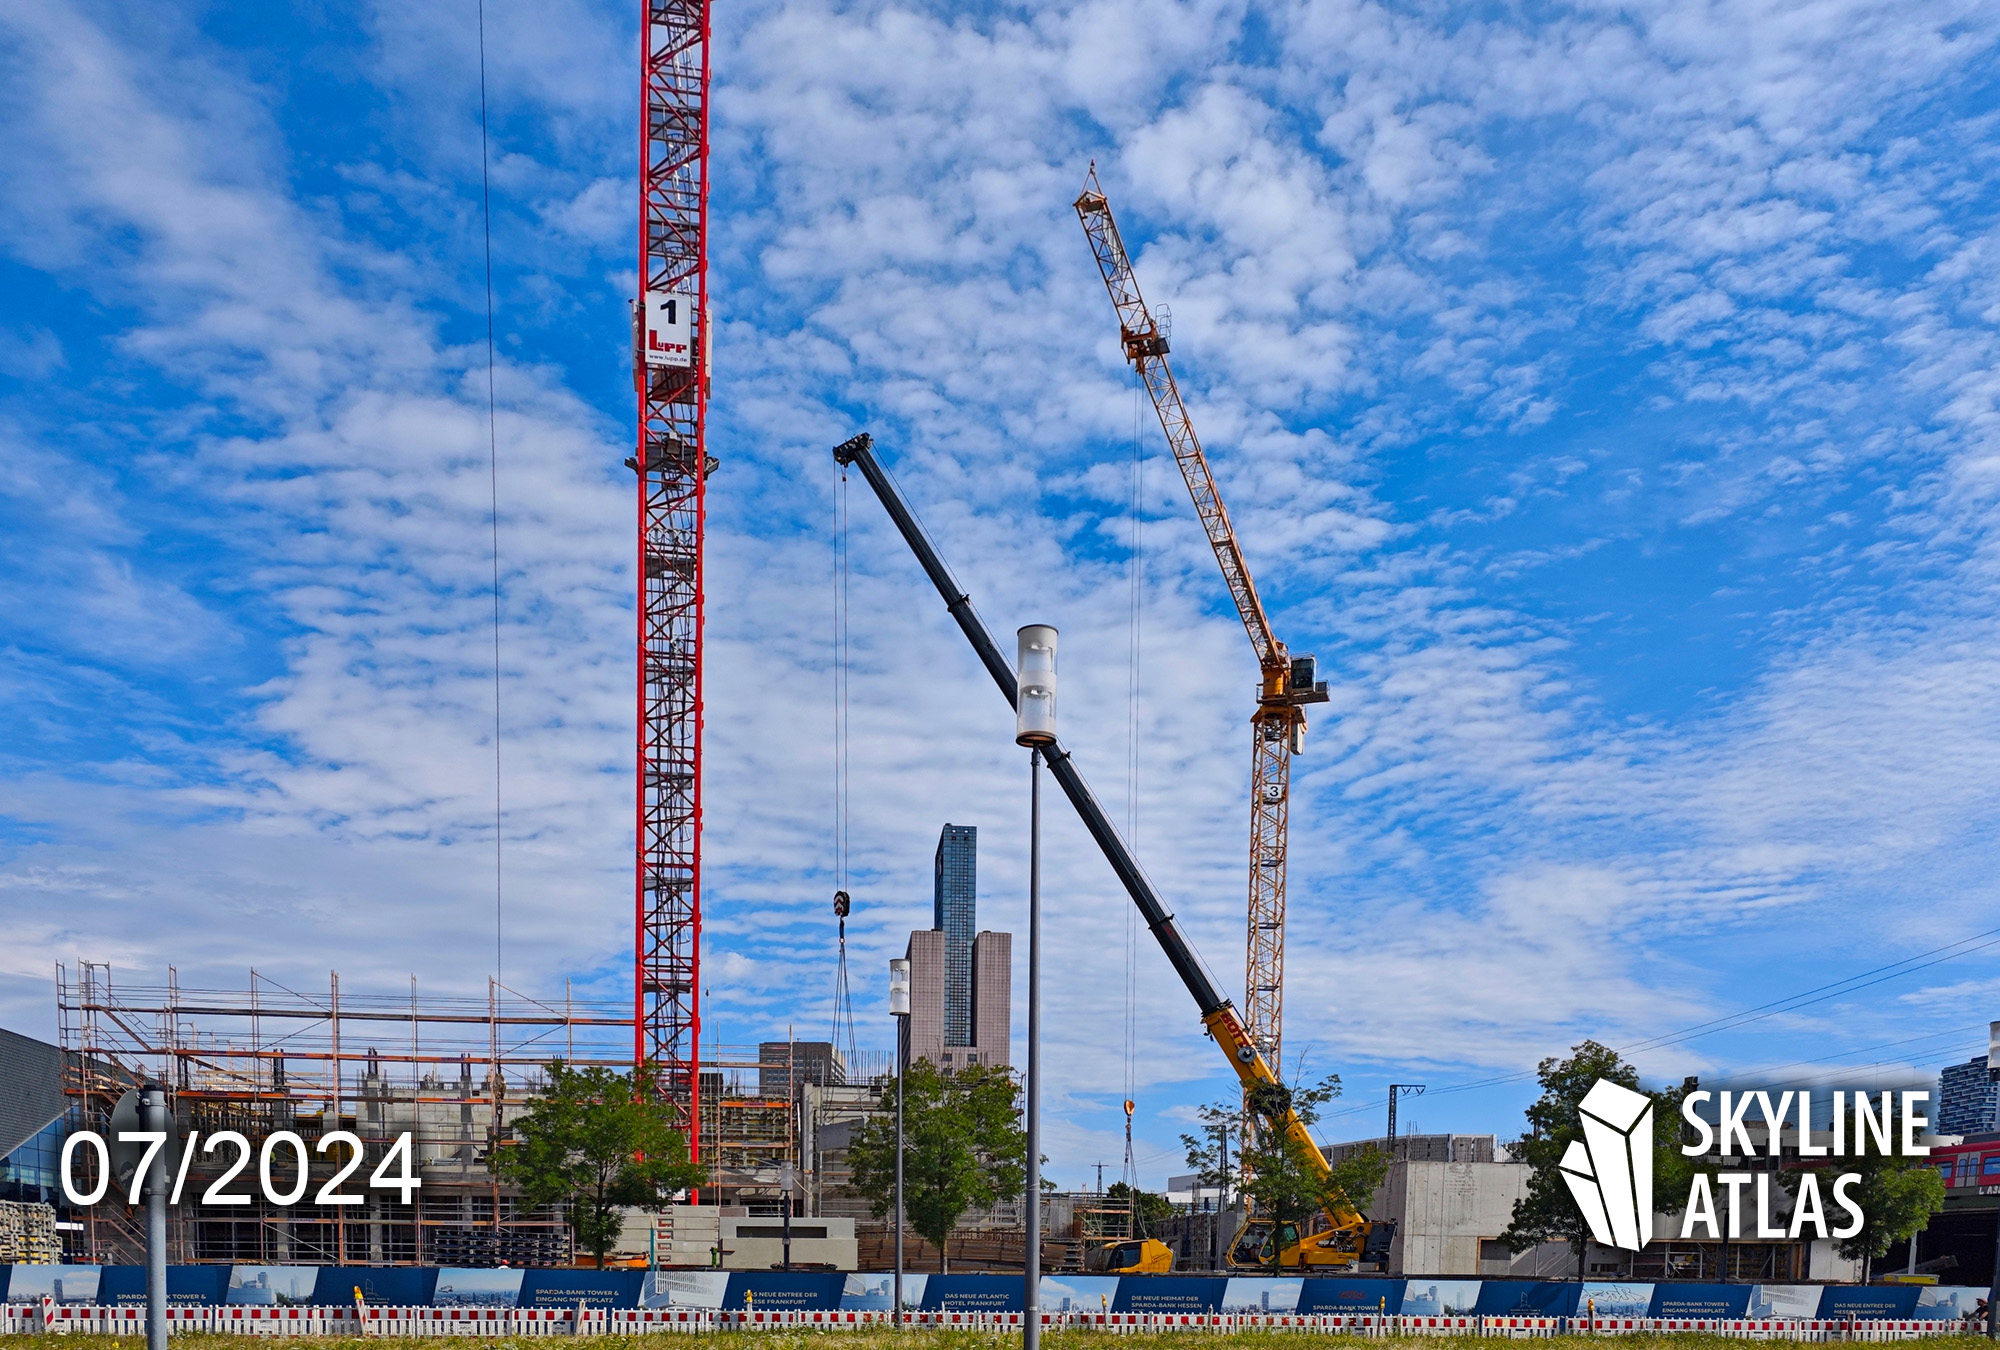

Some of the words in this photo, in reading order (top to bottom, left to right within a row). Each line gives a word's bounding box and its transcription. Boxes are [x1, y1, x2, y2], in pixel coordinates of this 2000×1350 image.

[660, 299, 676, 325] 1
[649, 354, 688, 363] www.lupp.de
[1269, 785, 1279, 797] 3
